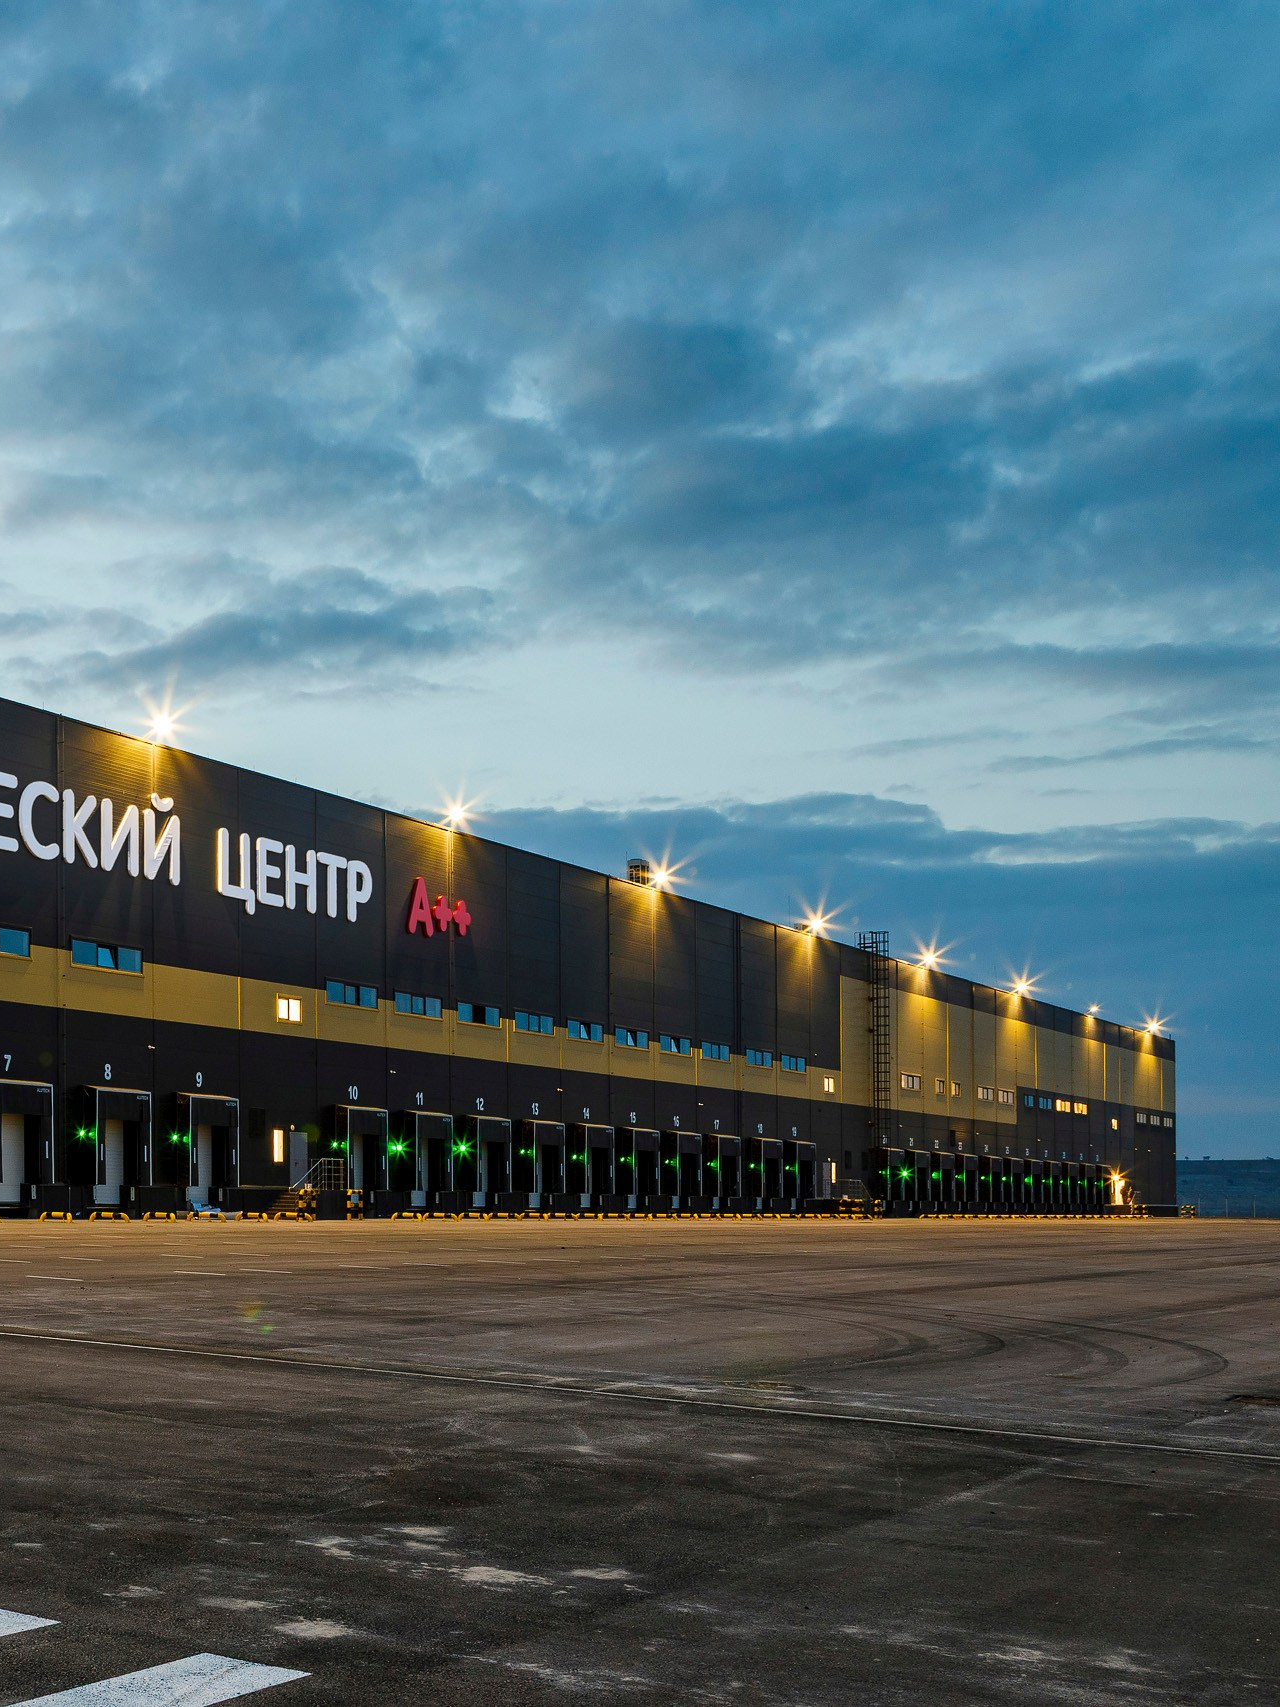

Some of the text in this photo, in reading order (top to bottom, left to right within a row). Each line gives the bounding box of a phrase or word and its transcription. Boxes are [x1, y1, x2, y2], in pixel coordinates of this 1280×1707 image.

[217, 826, 373, 923] ЦЕНТР
[3, 1054, 12, 1072] 7
[104, 1063, 112, 1081] 8
[195, 1071, 203, 1088] 9
[347, 1085, 359, 1101] 10
[415, 1091, 424, 1106] 11
[475, 1097, 485, 1111] 12
[531, 1102, 539, 1116] 13
[583, 1107, 590, 1120] 14
[630, 1111, 637, 1124] 15
[714, 1119, 721, 1131] 17
